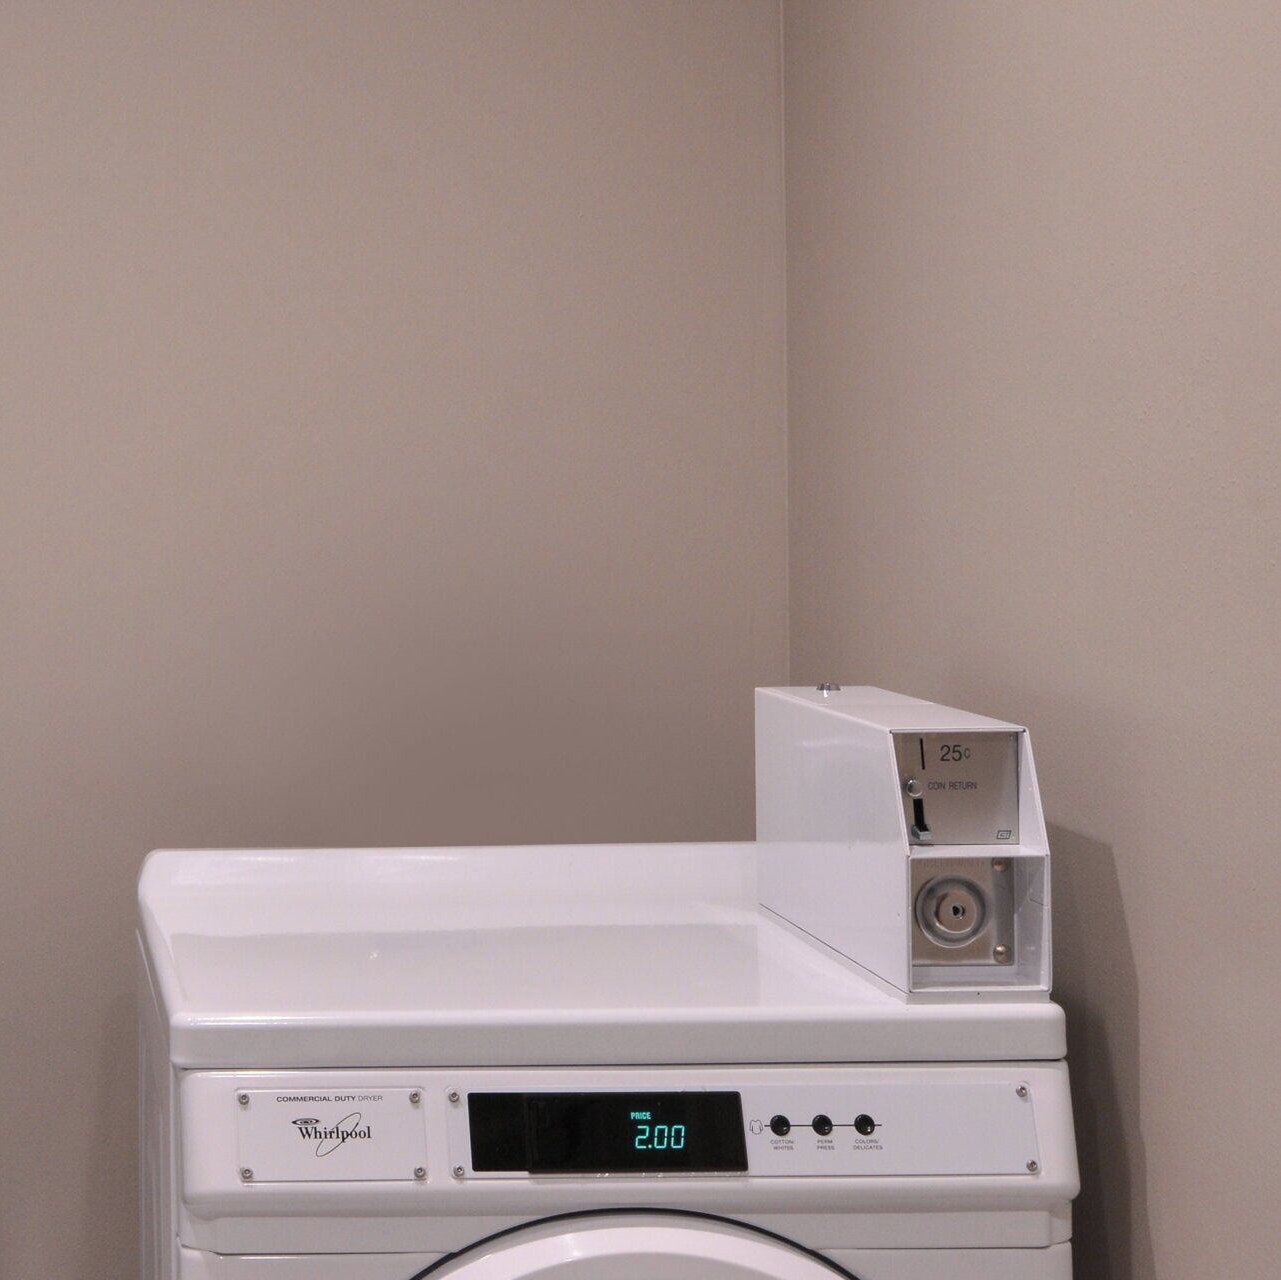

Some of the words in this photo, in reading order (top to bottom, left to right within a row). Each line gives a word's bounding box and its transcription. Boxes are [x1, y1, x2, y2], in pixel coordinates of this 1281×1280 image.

[927, 782, 946, 791] COIN
[948, 781, 977, 791] RETURN
[630, 1111, 652, 1120] PRICE
[298, 1126, 372, 1143] Whirlpool
[634, 1125, 686, 1150] 2.00
